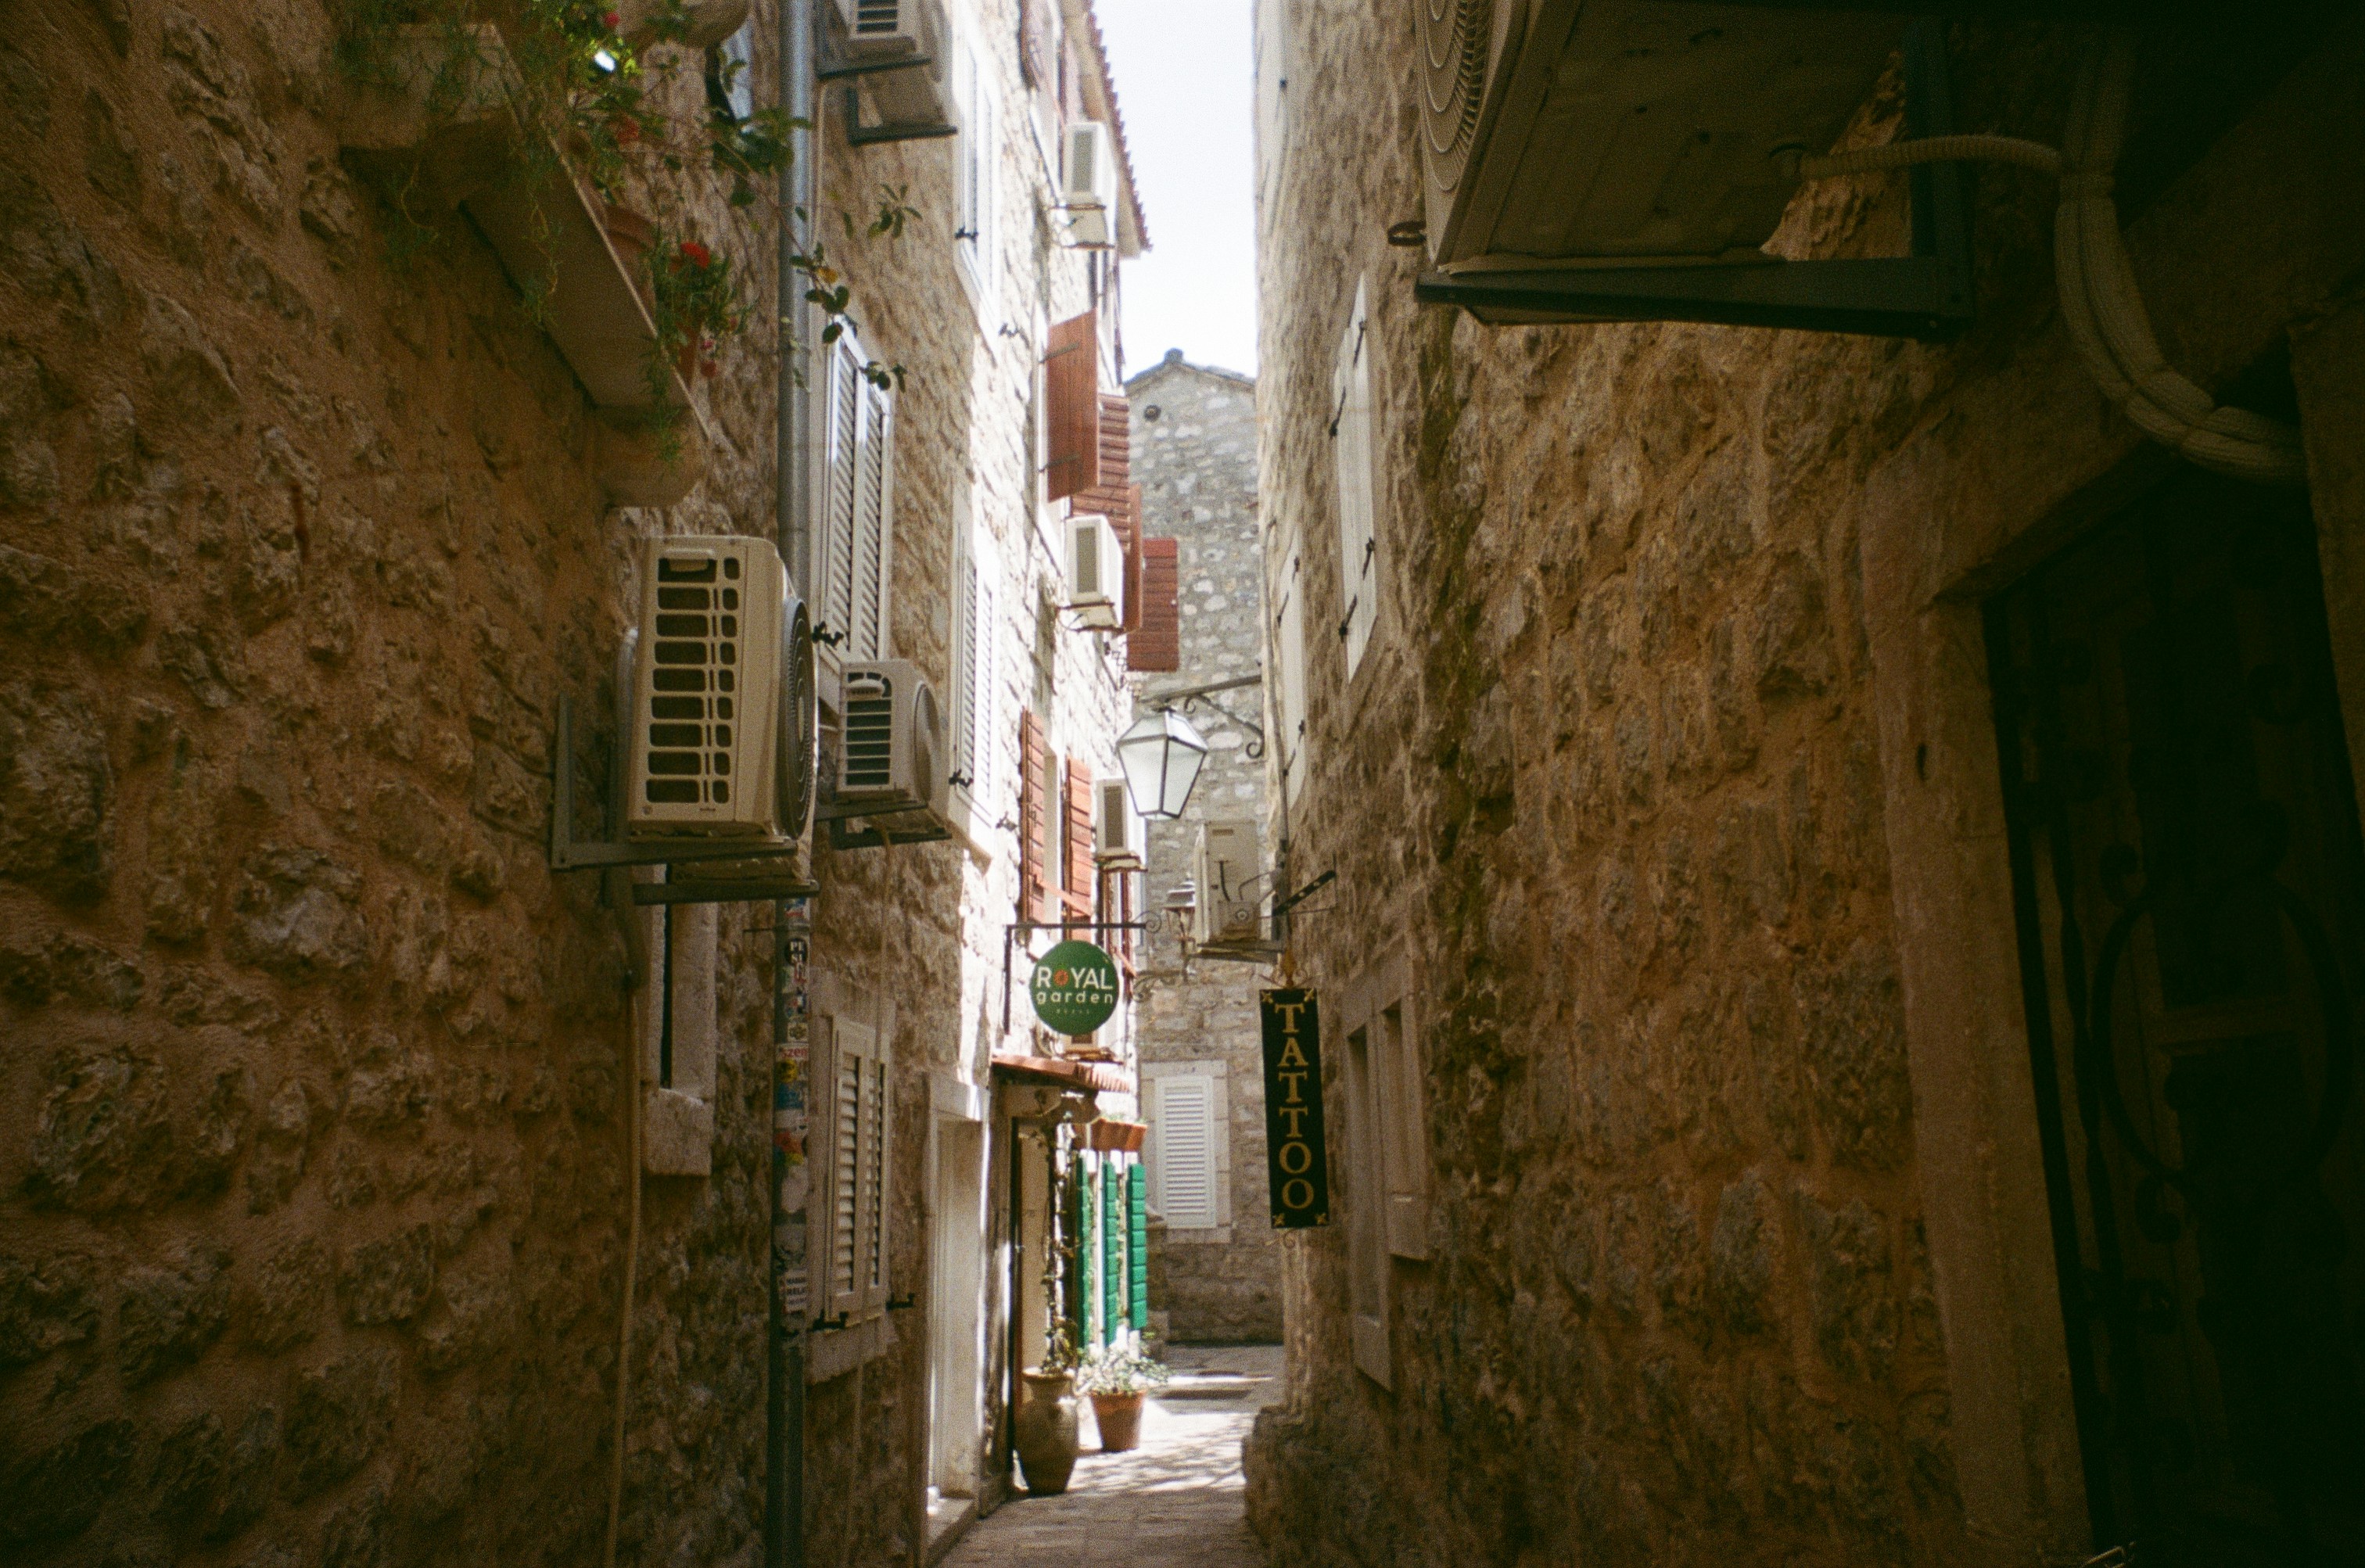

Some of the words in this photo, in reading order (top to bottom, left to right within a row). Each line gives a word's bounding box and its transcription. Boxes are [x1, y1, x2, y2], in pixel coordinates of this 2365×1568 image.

[1037, 966, 1113, 990] ROYAL
[1037, 990, 1113, 1005] garden
[1275, 1003, 1315, 1209] TATTOO
